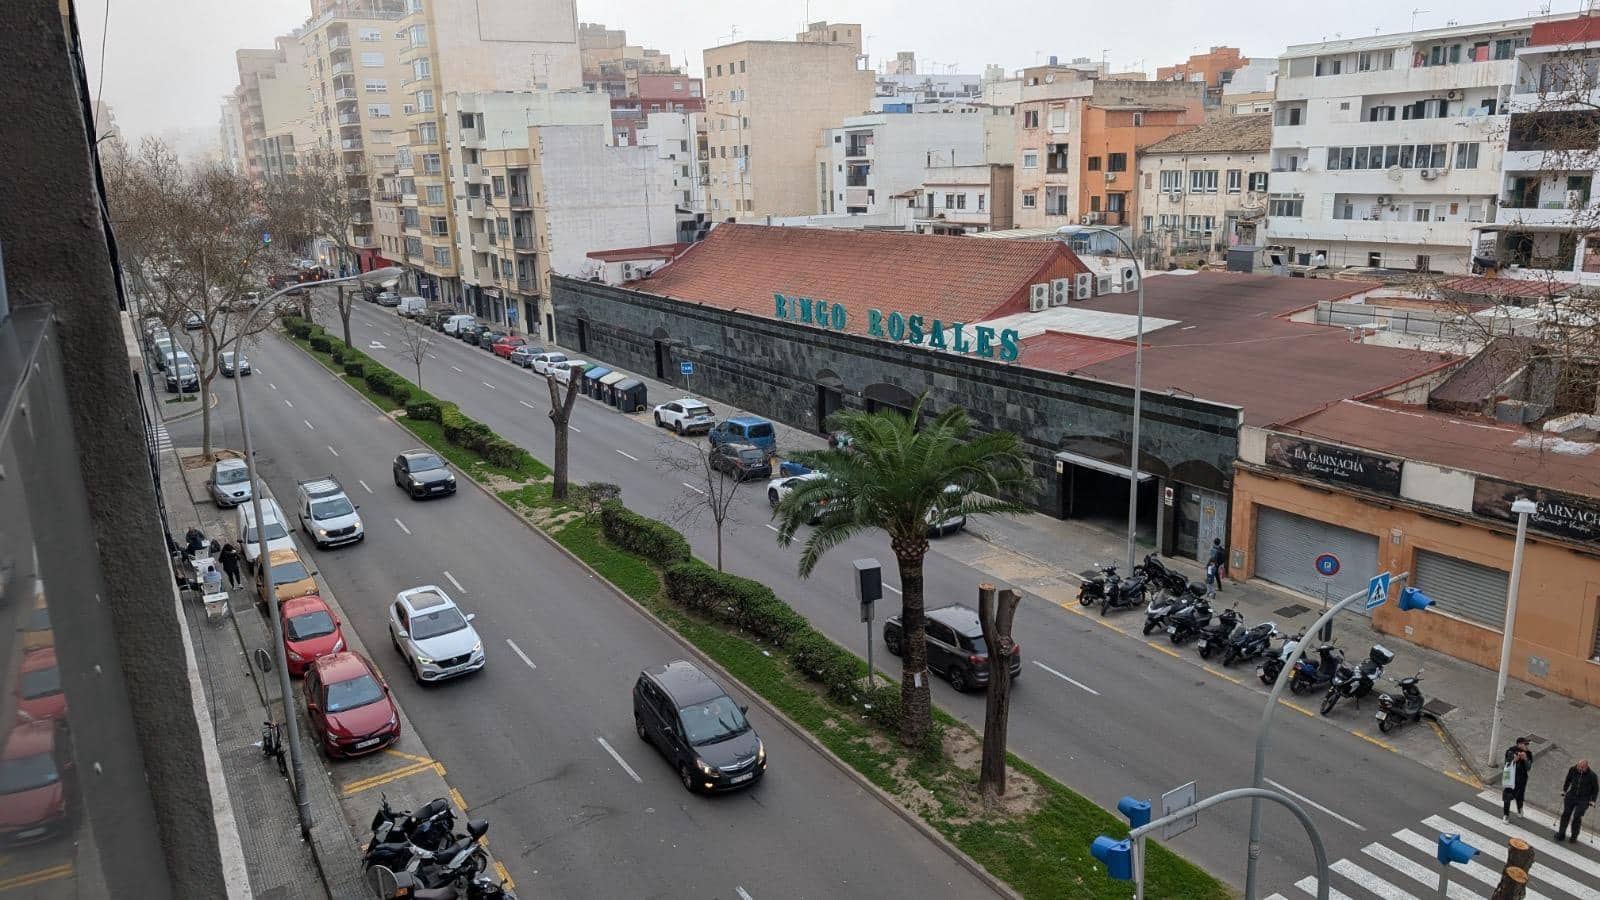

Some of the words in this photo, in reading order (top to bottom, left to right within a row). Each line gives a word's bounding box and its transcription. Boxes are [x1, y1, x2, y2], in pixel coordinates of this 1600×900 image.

[774, 293, 847, 331] BINGO
[867, 308, 1020, 362] ROSALES
[1294, 448, 1307, 460] LA
[1309, 452, 1364, 473] GARNACHA
